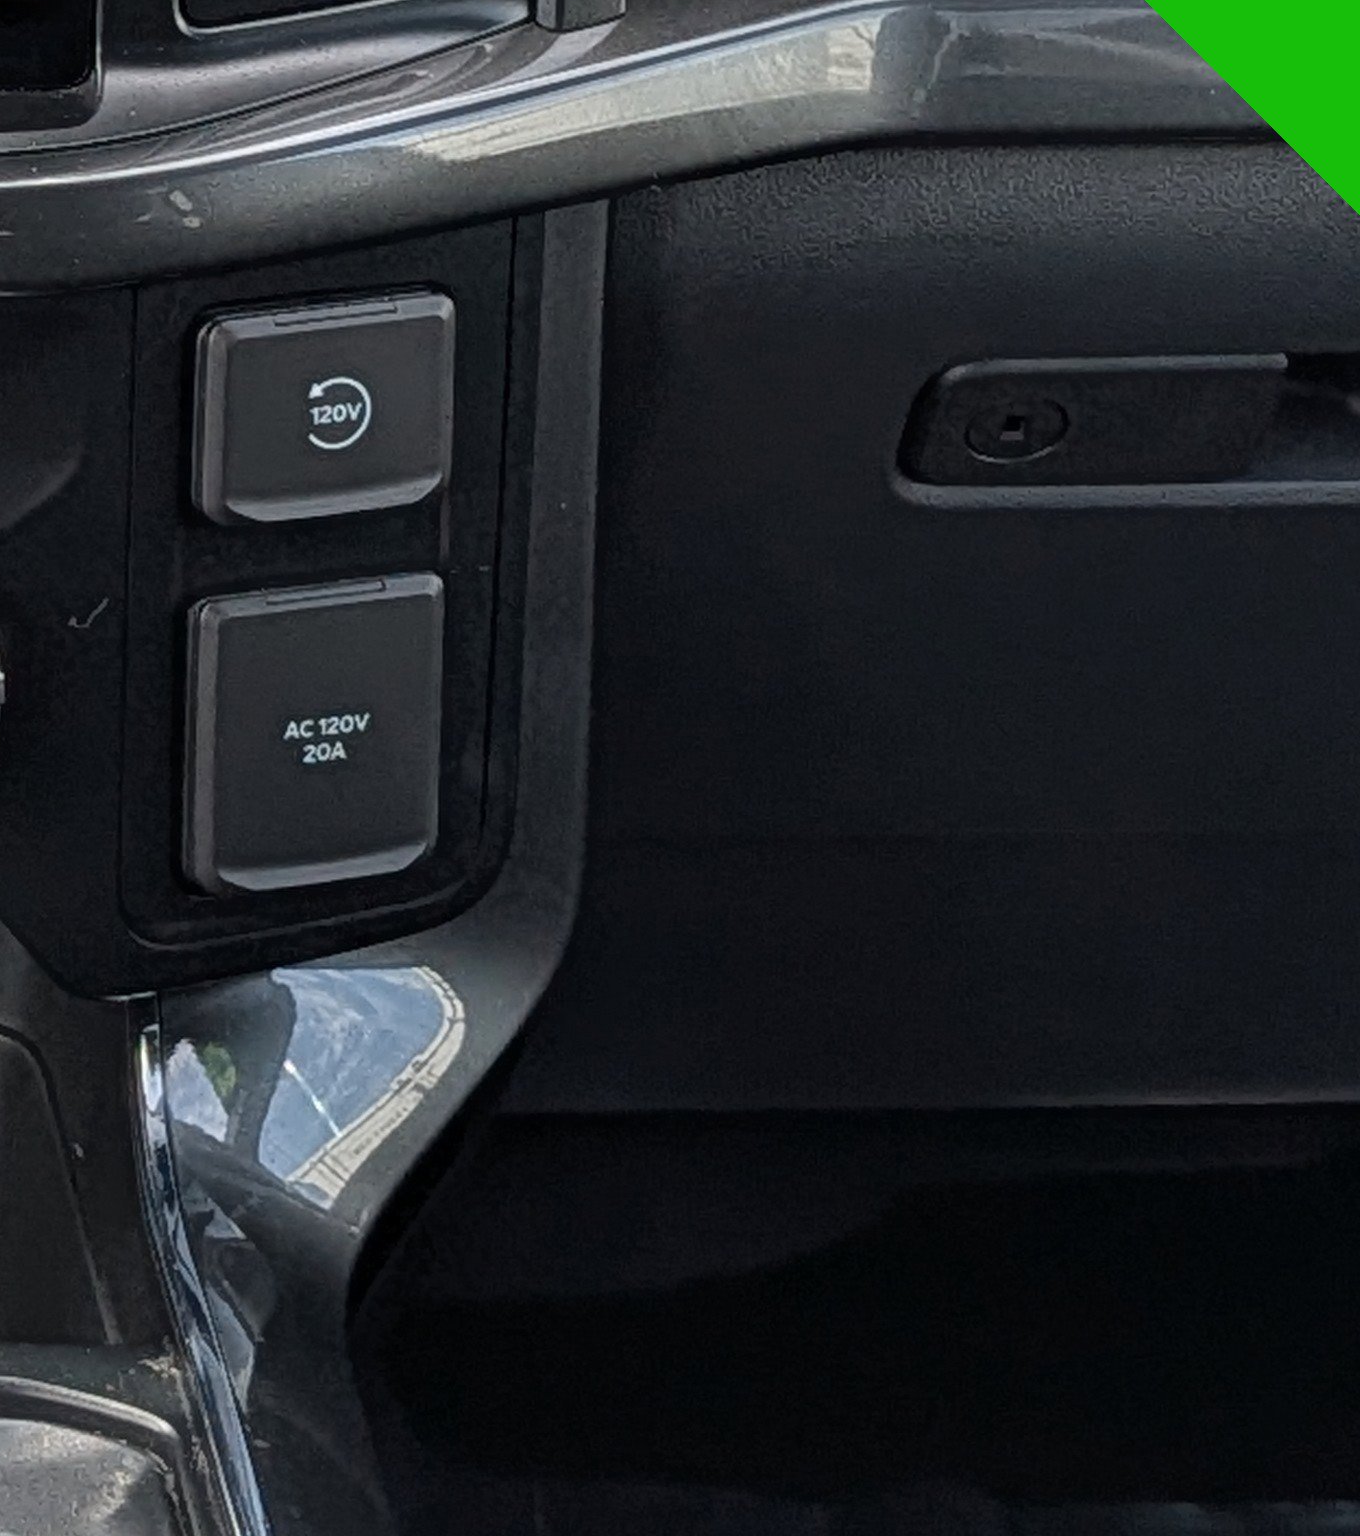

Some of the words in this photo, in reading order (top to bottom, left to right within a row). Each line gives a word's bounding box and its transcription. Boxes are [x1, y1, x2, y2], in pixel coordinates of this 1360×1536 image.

[310, 401, 365, 426] 120V
[283, 718, 315, 740] AC
[318, 712, 370, 736] 120V
[302, 741, 348, 764] 20A
